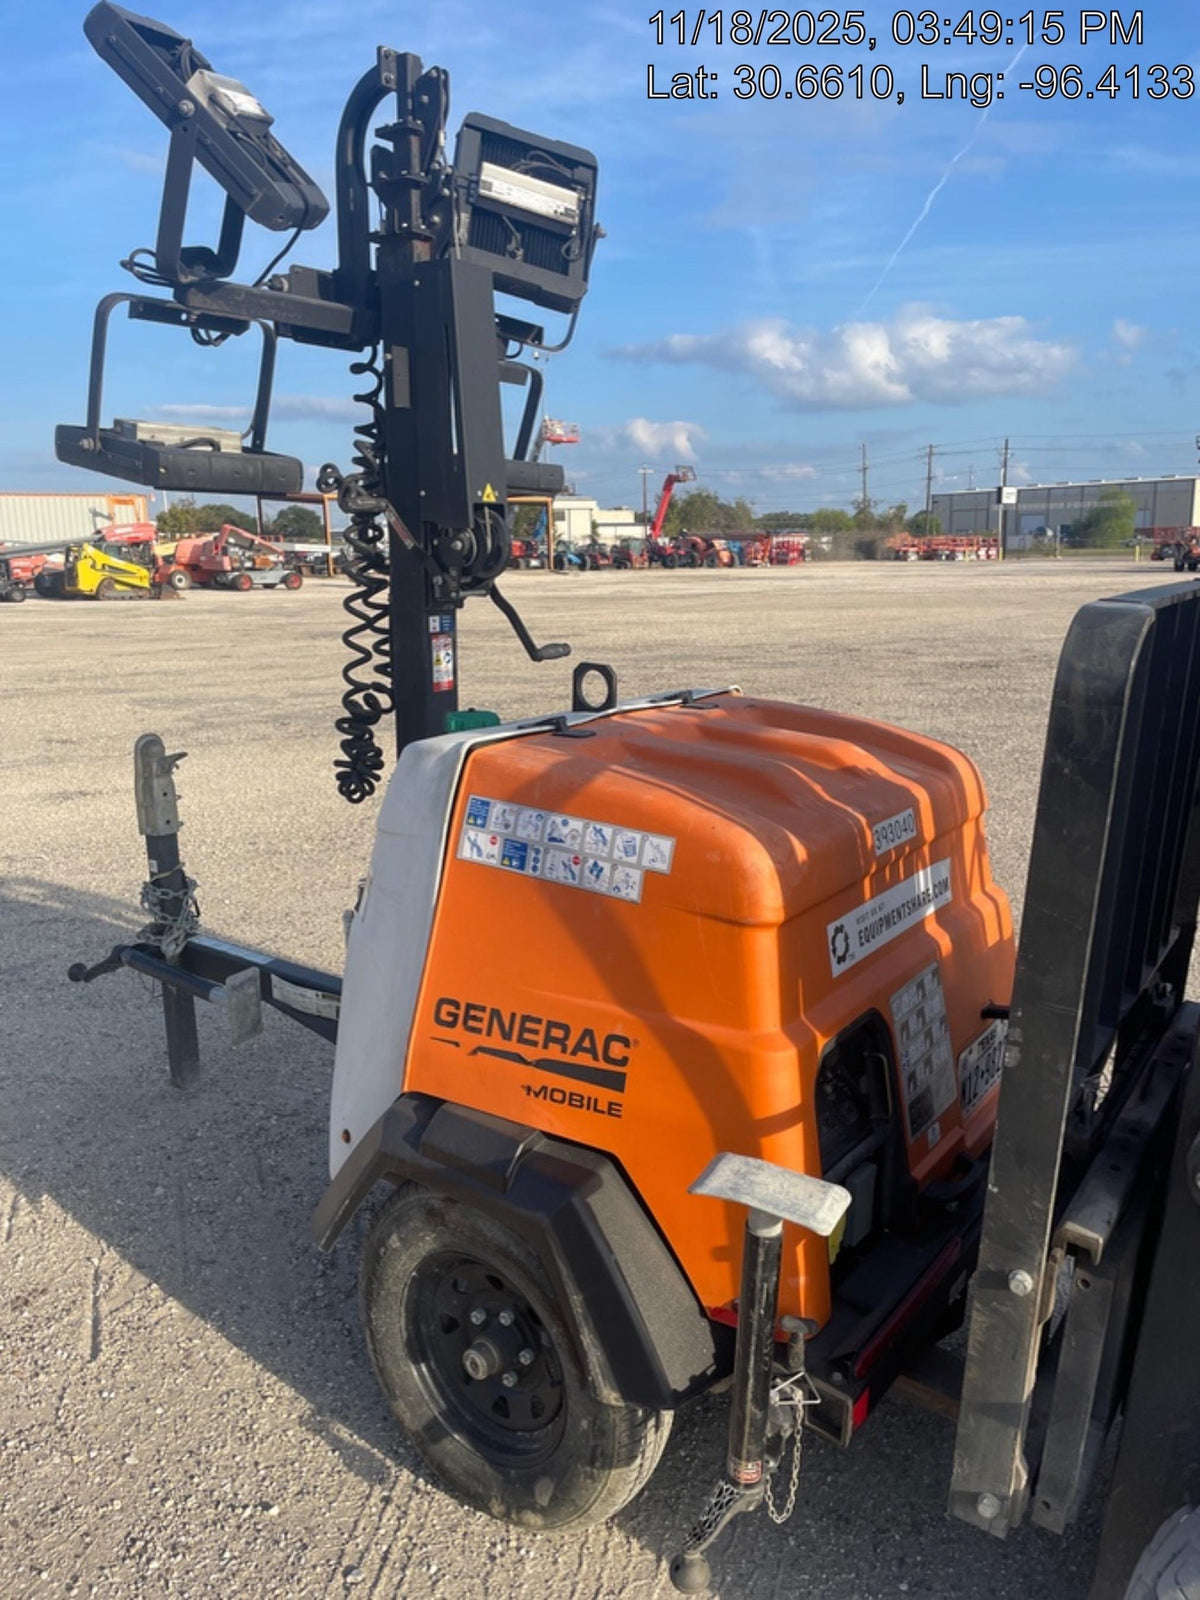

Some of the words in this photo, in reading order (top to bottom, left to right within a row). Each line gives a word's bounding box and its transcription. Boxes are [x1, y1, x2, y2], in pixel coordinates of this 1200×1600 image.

[873, 813, 915, 850] 393040
[858, 876, 949, 948] EQUIPMENTSHARE.COM
[433, 997, 630, 1067] GENERAC
[522, 1084, 624, 1119] MOBILE
